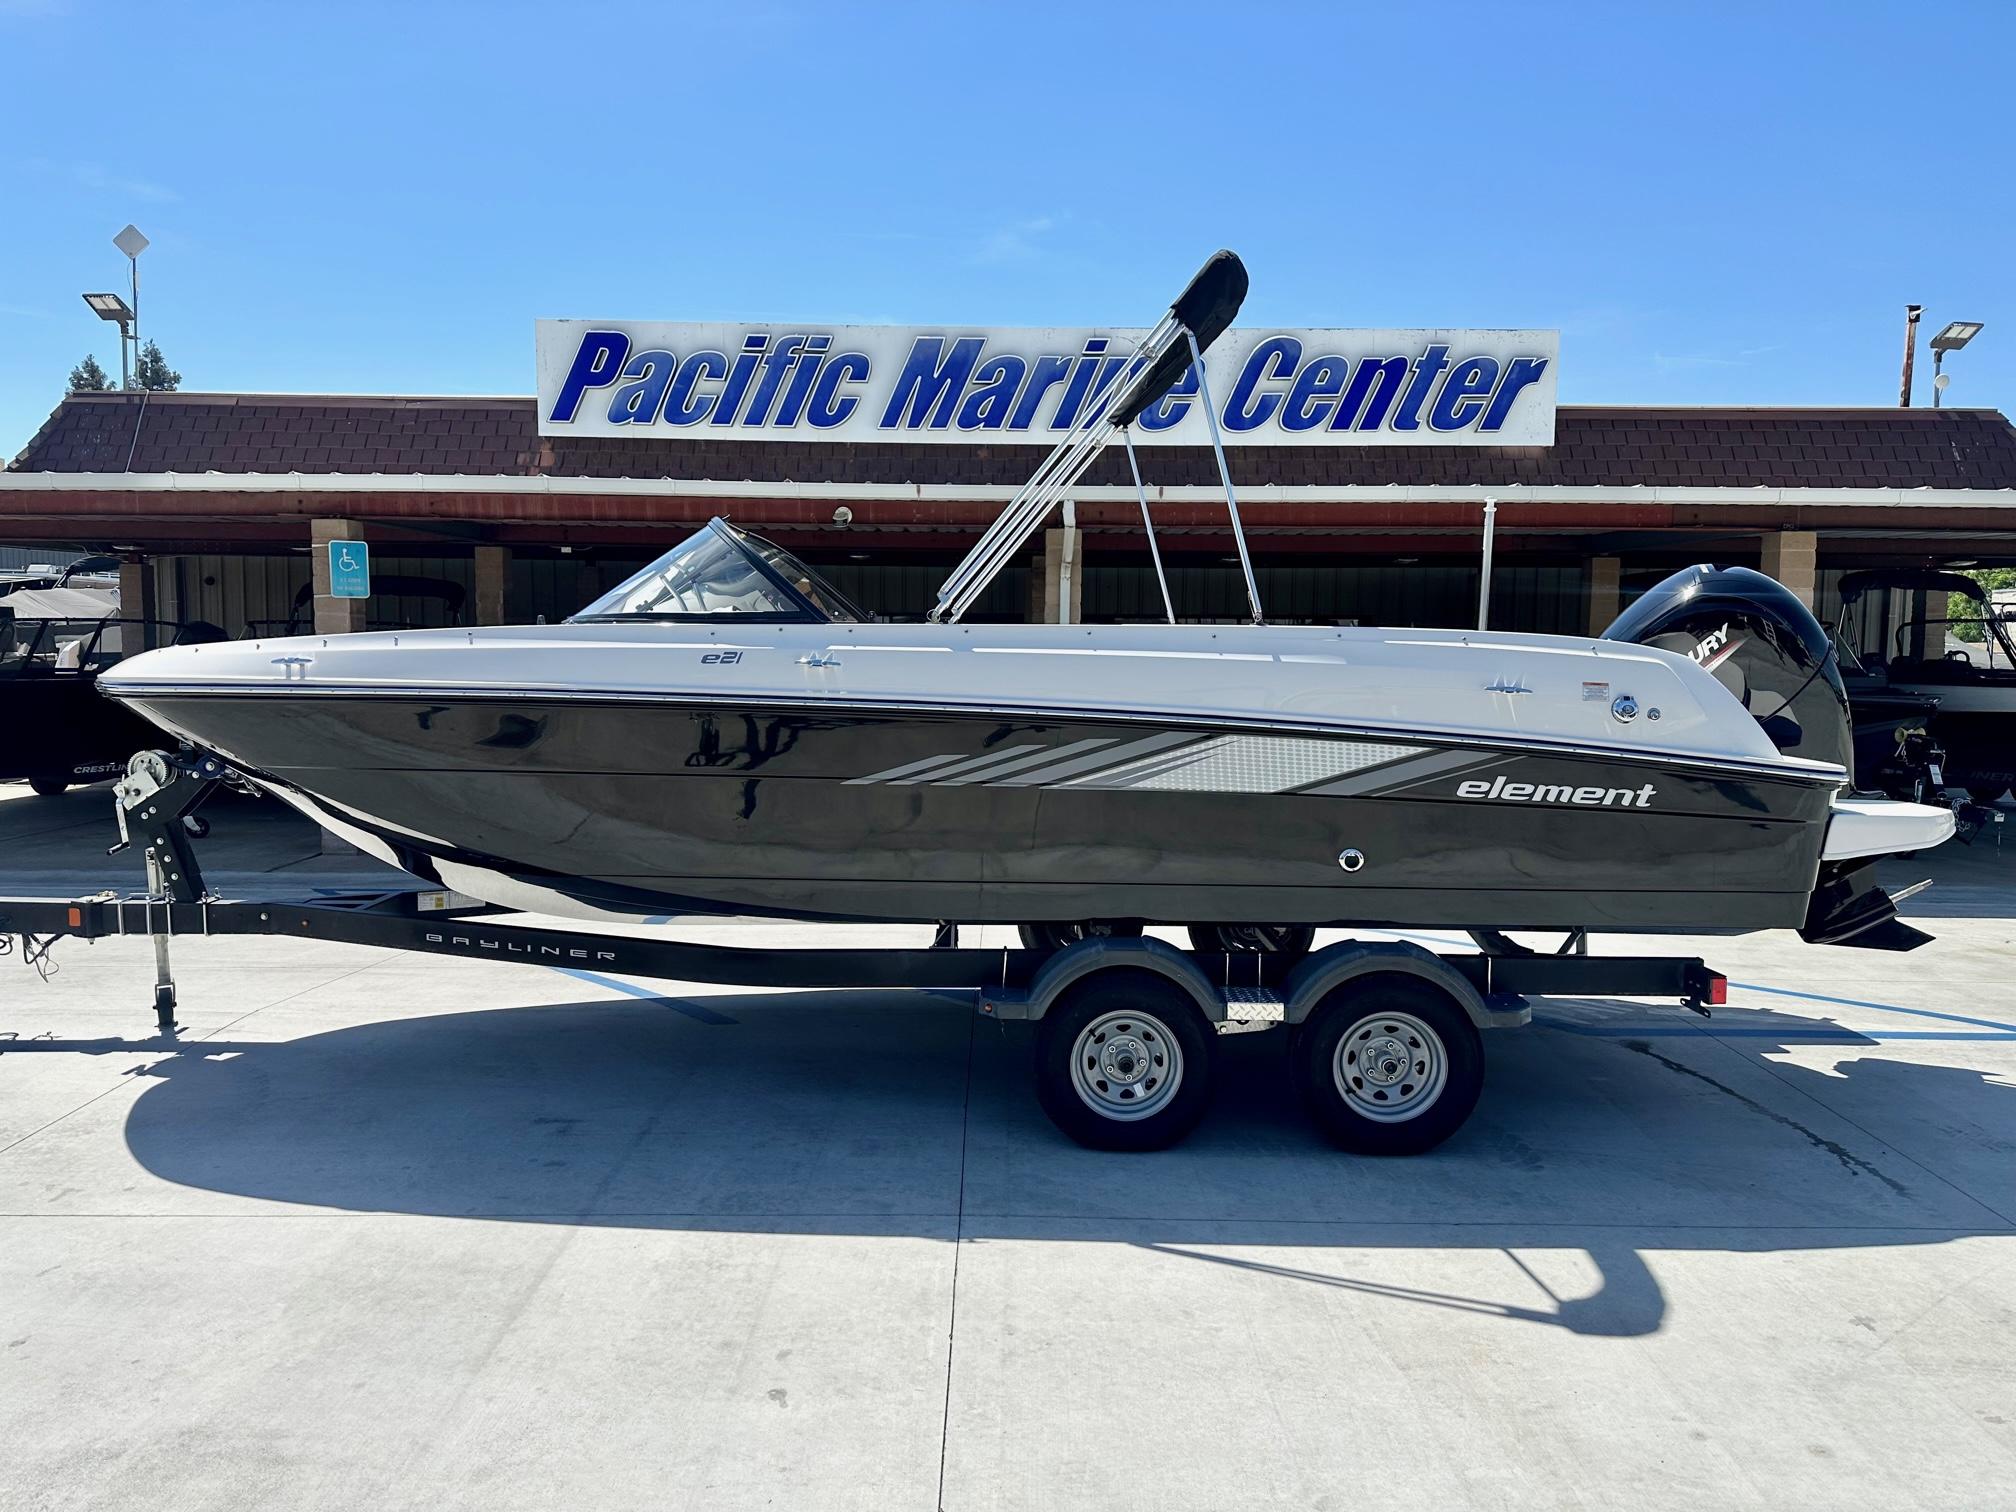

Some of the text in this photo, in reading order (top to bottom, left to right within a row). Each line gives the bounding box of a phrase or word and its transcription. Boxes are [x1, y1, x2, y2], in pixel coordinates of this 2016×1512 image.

[548, 329, 1550, 433] Pacific Marine Center
[1456, 775, 1657, 807] element
[426, 933, 616, 961] BAYLINER
